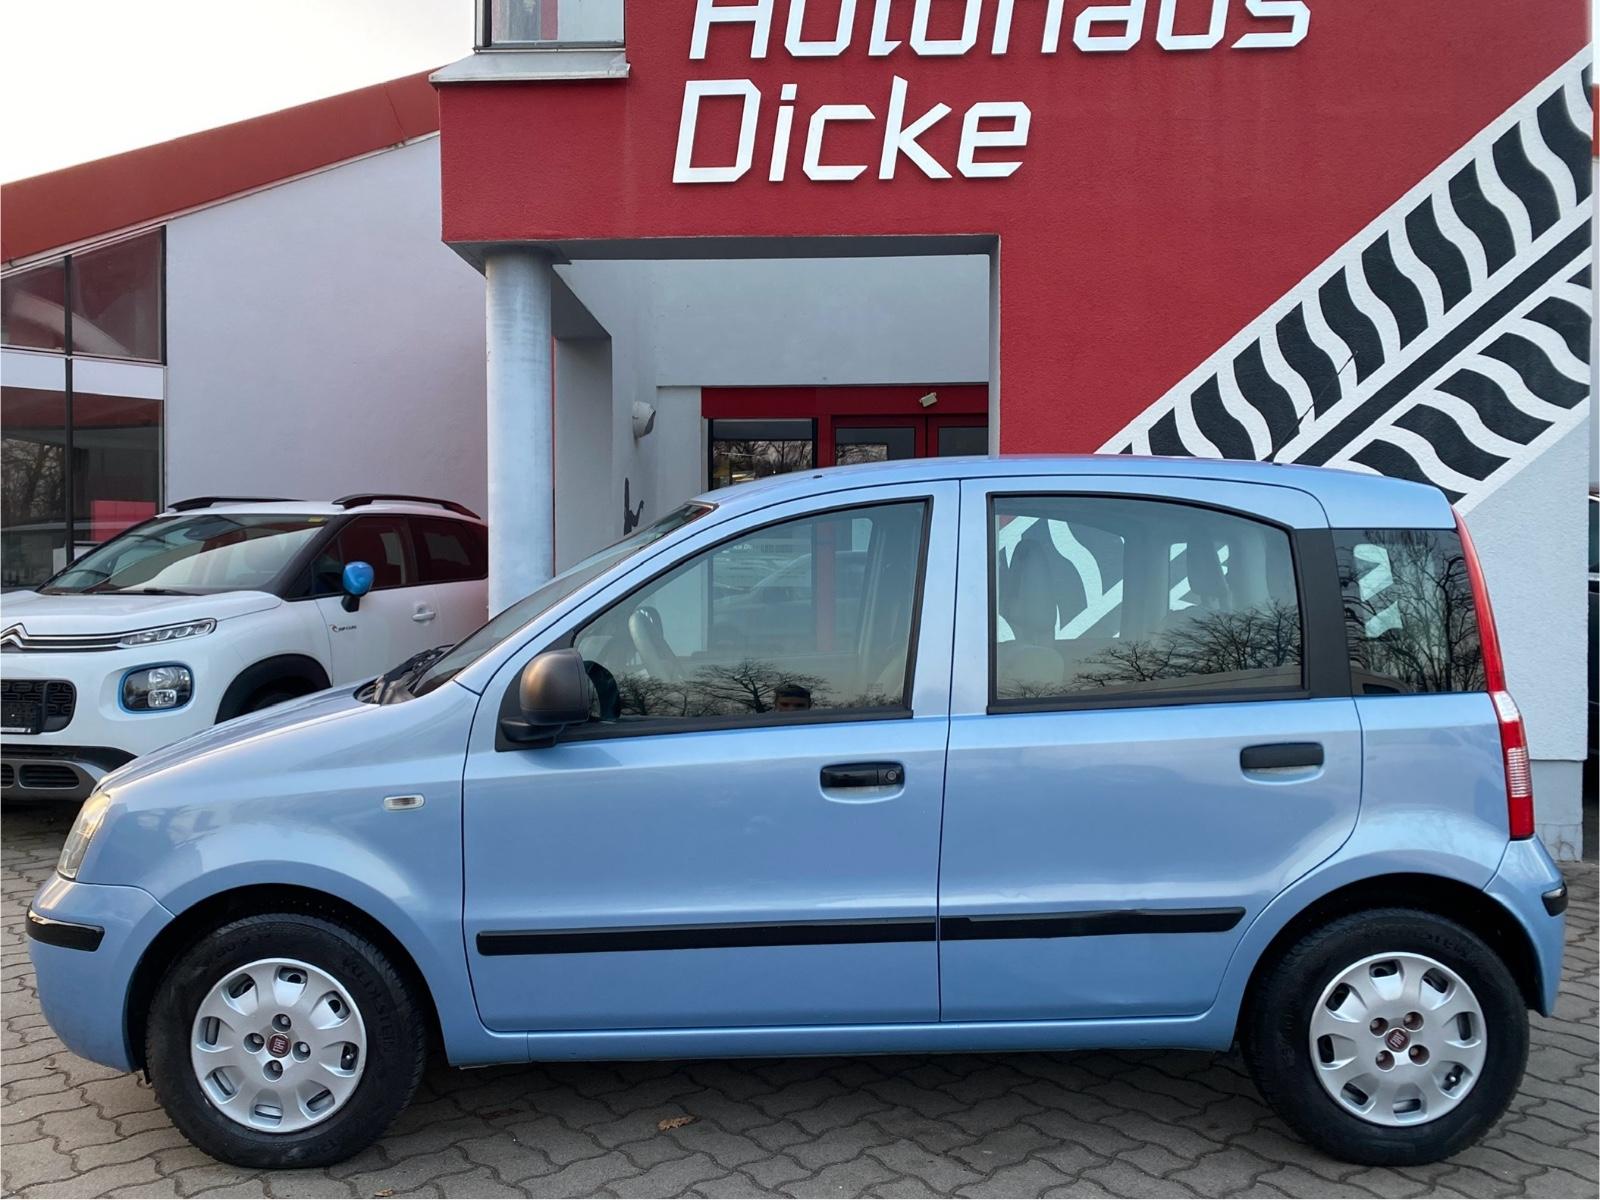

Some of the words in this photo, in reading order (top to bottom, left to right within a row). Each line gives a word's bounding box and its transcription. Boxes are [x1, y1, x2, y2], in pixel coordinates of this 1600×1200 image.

[688, 0, 1311, 60] Autohaus
[673, 75, 1032, 184] Dicke
[272, 1038, 285, 1053] FIAT
